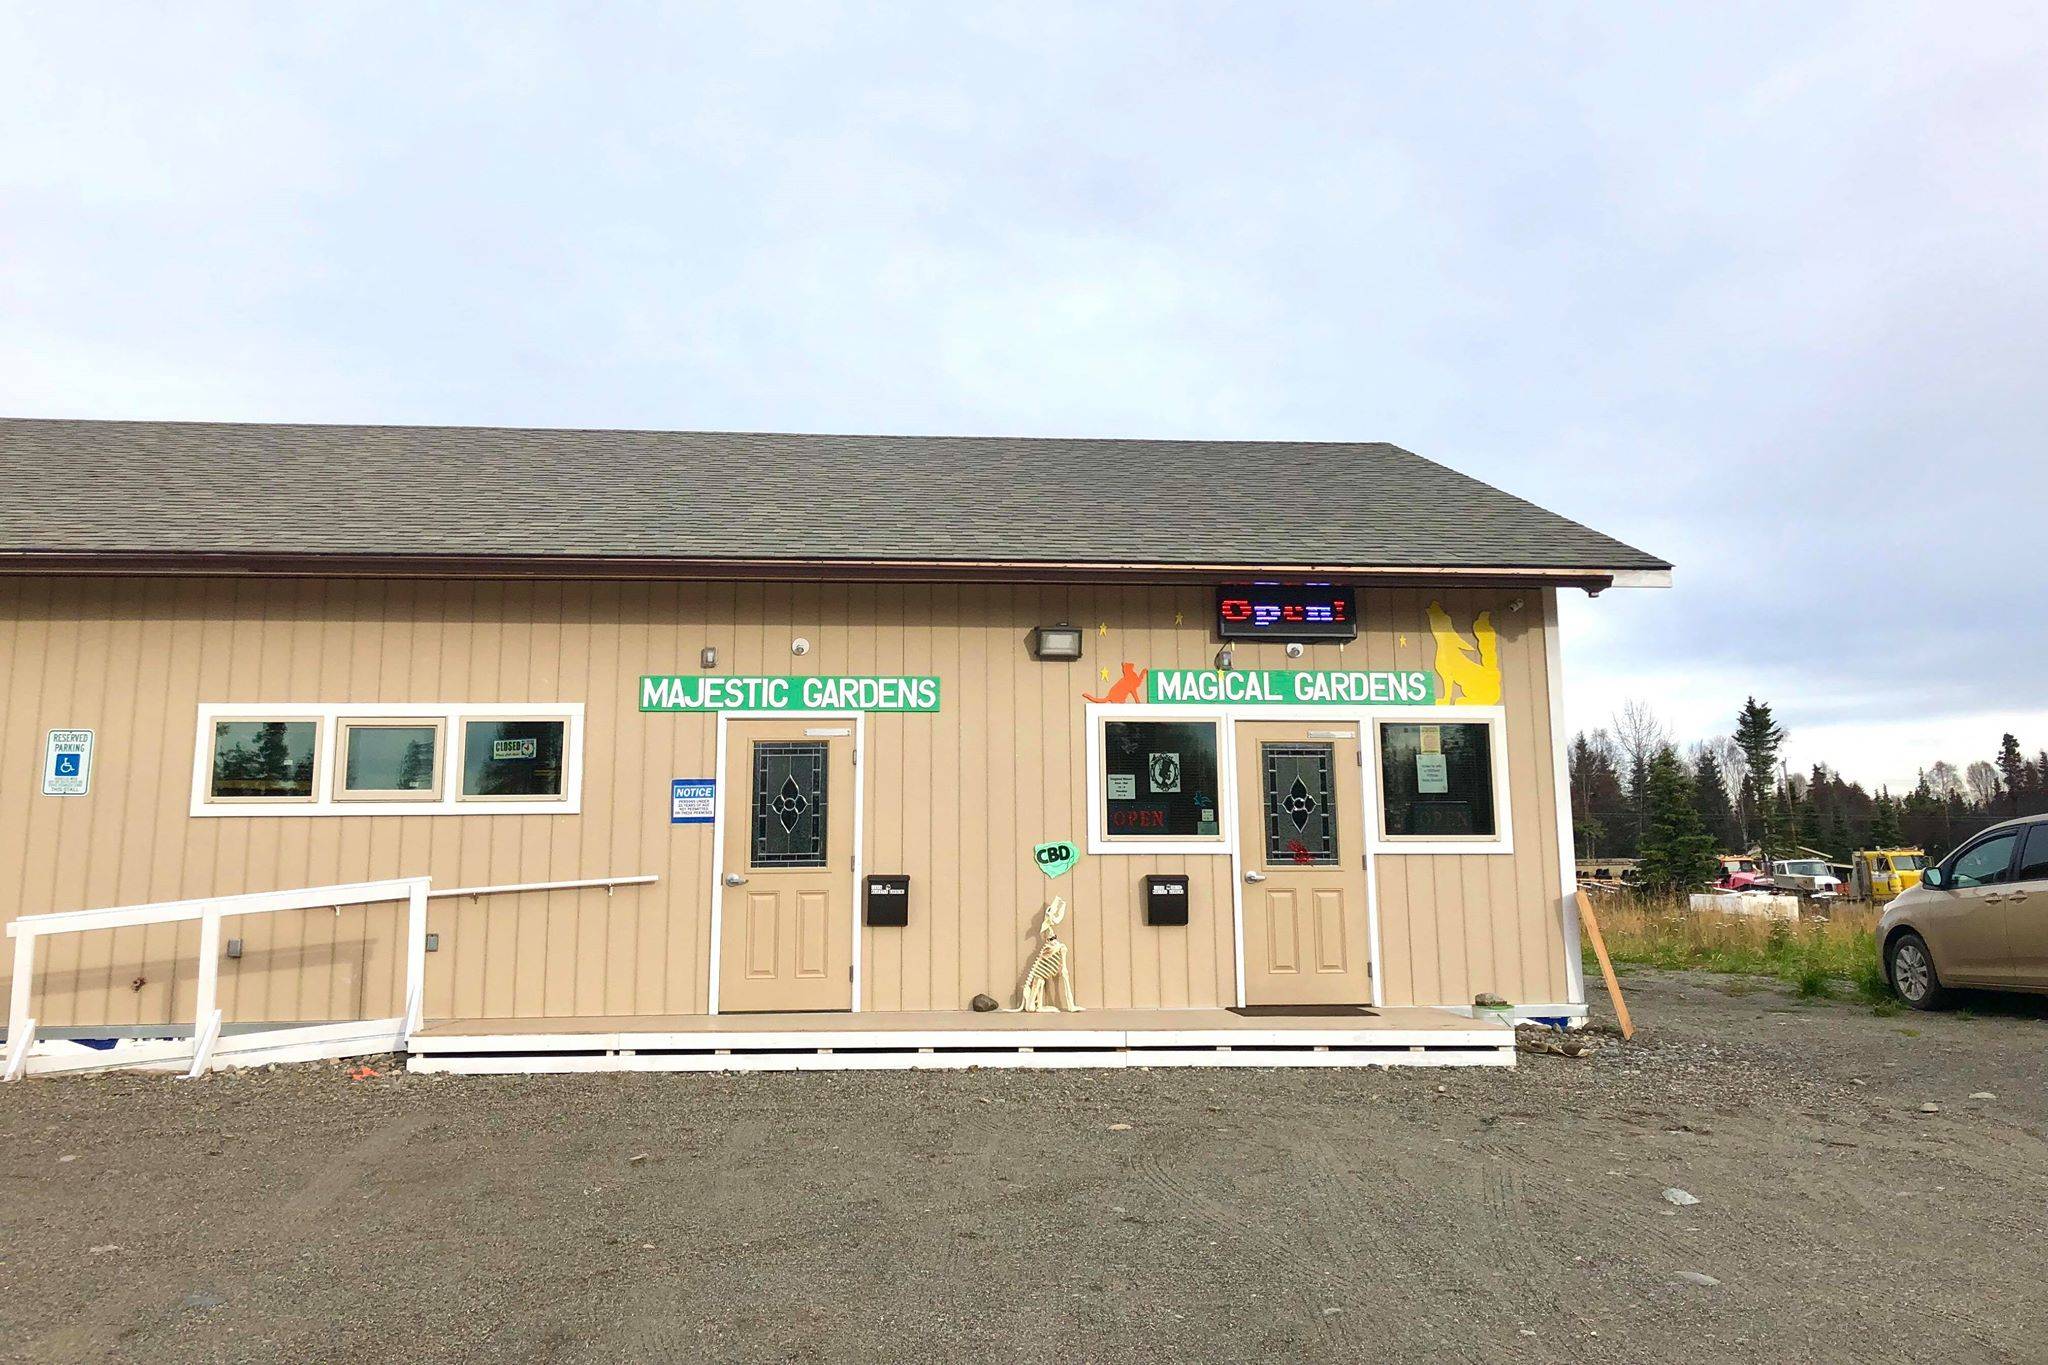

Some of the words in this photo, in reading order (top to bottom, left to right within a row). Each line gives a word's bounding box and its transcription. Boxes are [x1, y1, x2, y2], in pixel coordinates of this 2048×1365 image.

[642, 677, 789, 708] MAJESTIC
[802, 678, 937, 708] GARDENS
[1157, 671, 1283, 701] MAGICAL
[1294, 672, 1427, 702] GARDENS
[53, 734, 88, 742] RESERVED
[54, 744, 84, 752] PARKING
[495, 741, 521, 751] CLOSED
[676, 788, 712, 797] NOTICE
[1113, 810, 1164, 828] OPEN
[1037, 845, 1070, 864] CBD
